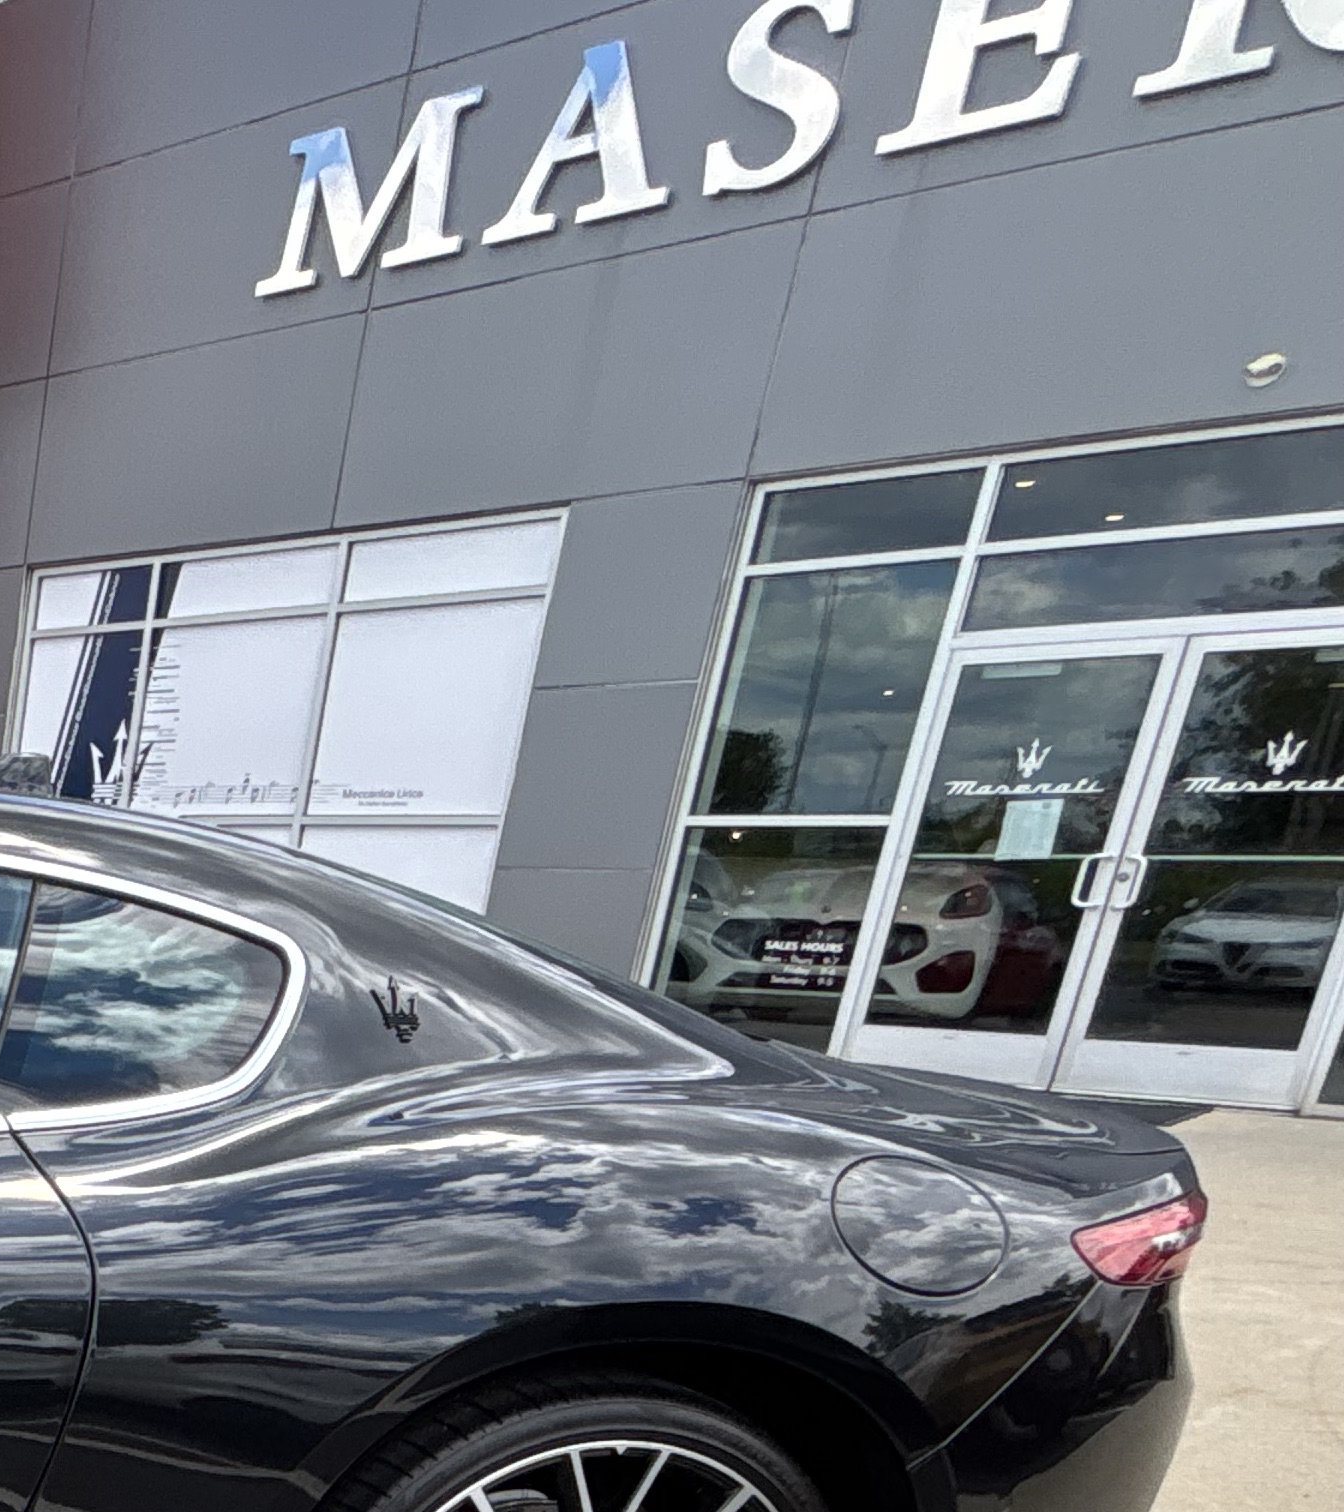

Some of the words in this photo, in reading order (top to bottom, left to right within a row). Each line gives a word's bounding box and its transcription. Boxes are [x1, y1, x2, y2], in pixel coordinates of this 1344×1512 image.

[945, 777, 1106, 796] Maserati
[764, 940, 798, 951] SALES
[800, 942, 844, 953] HOURS
